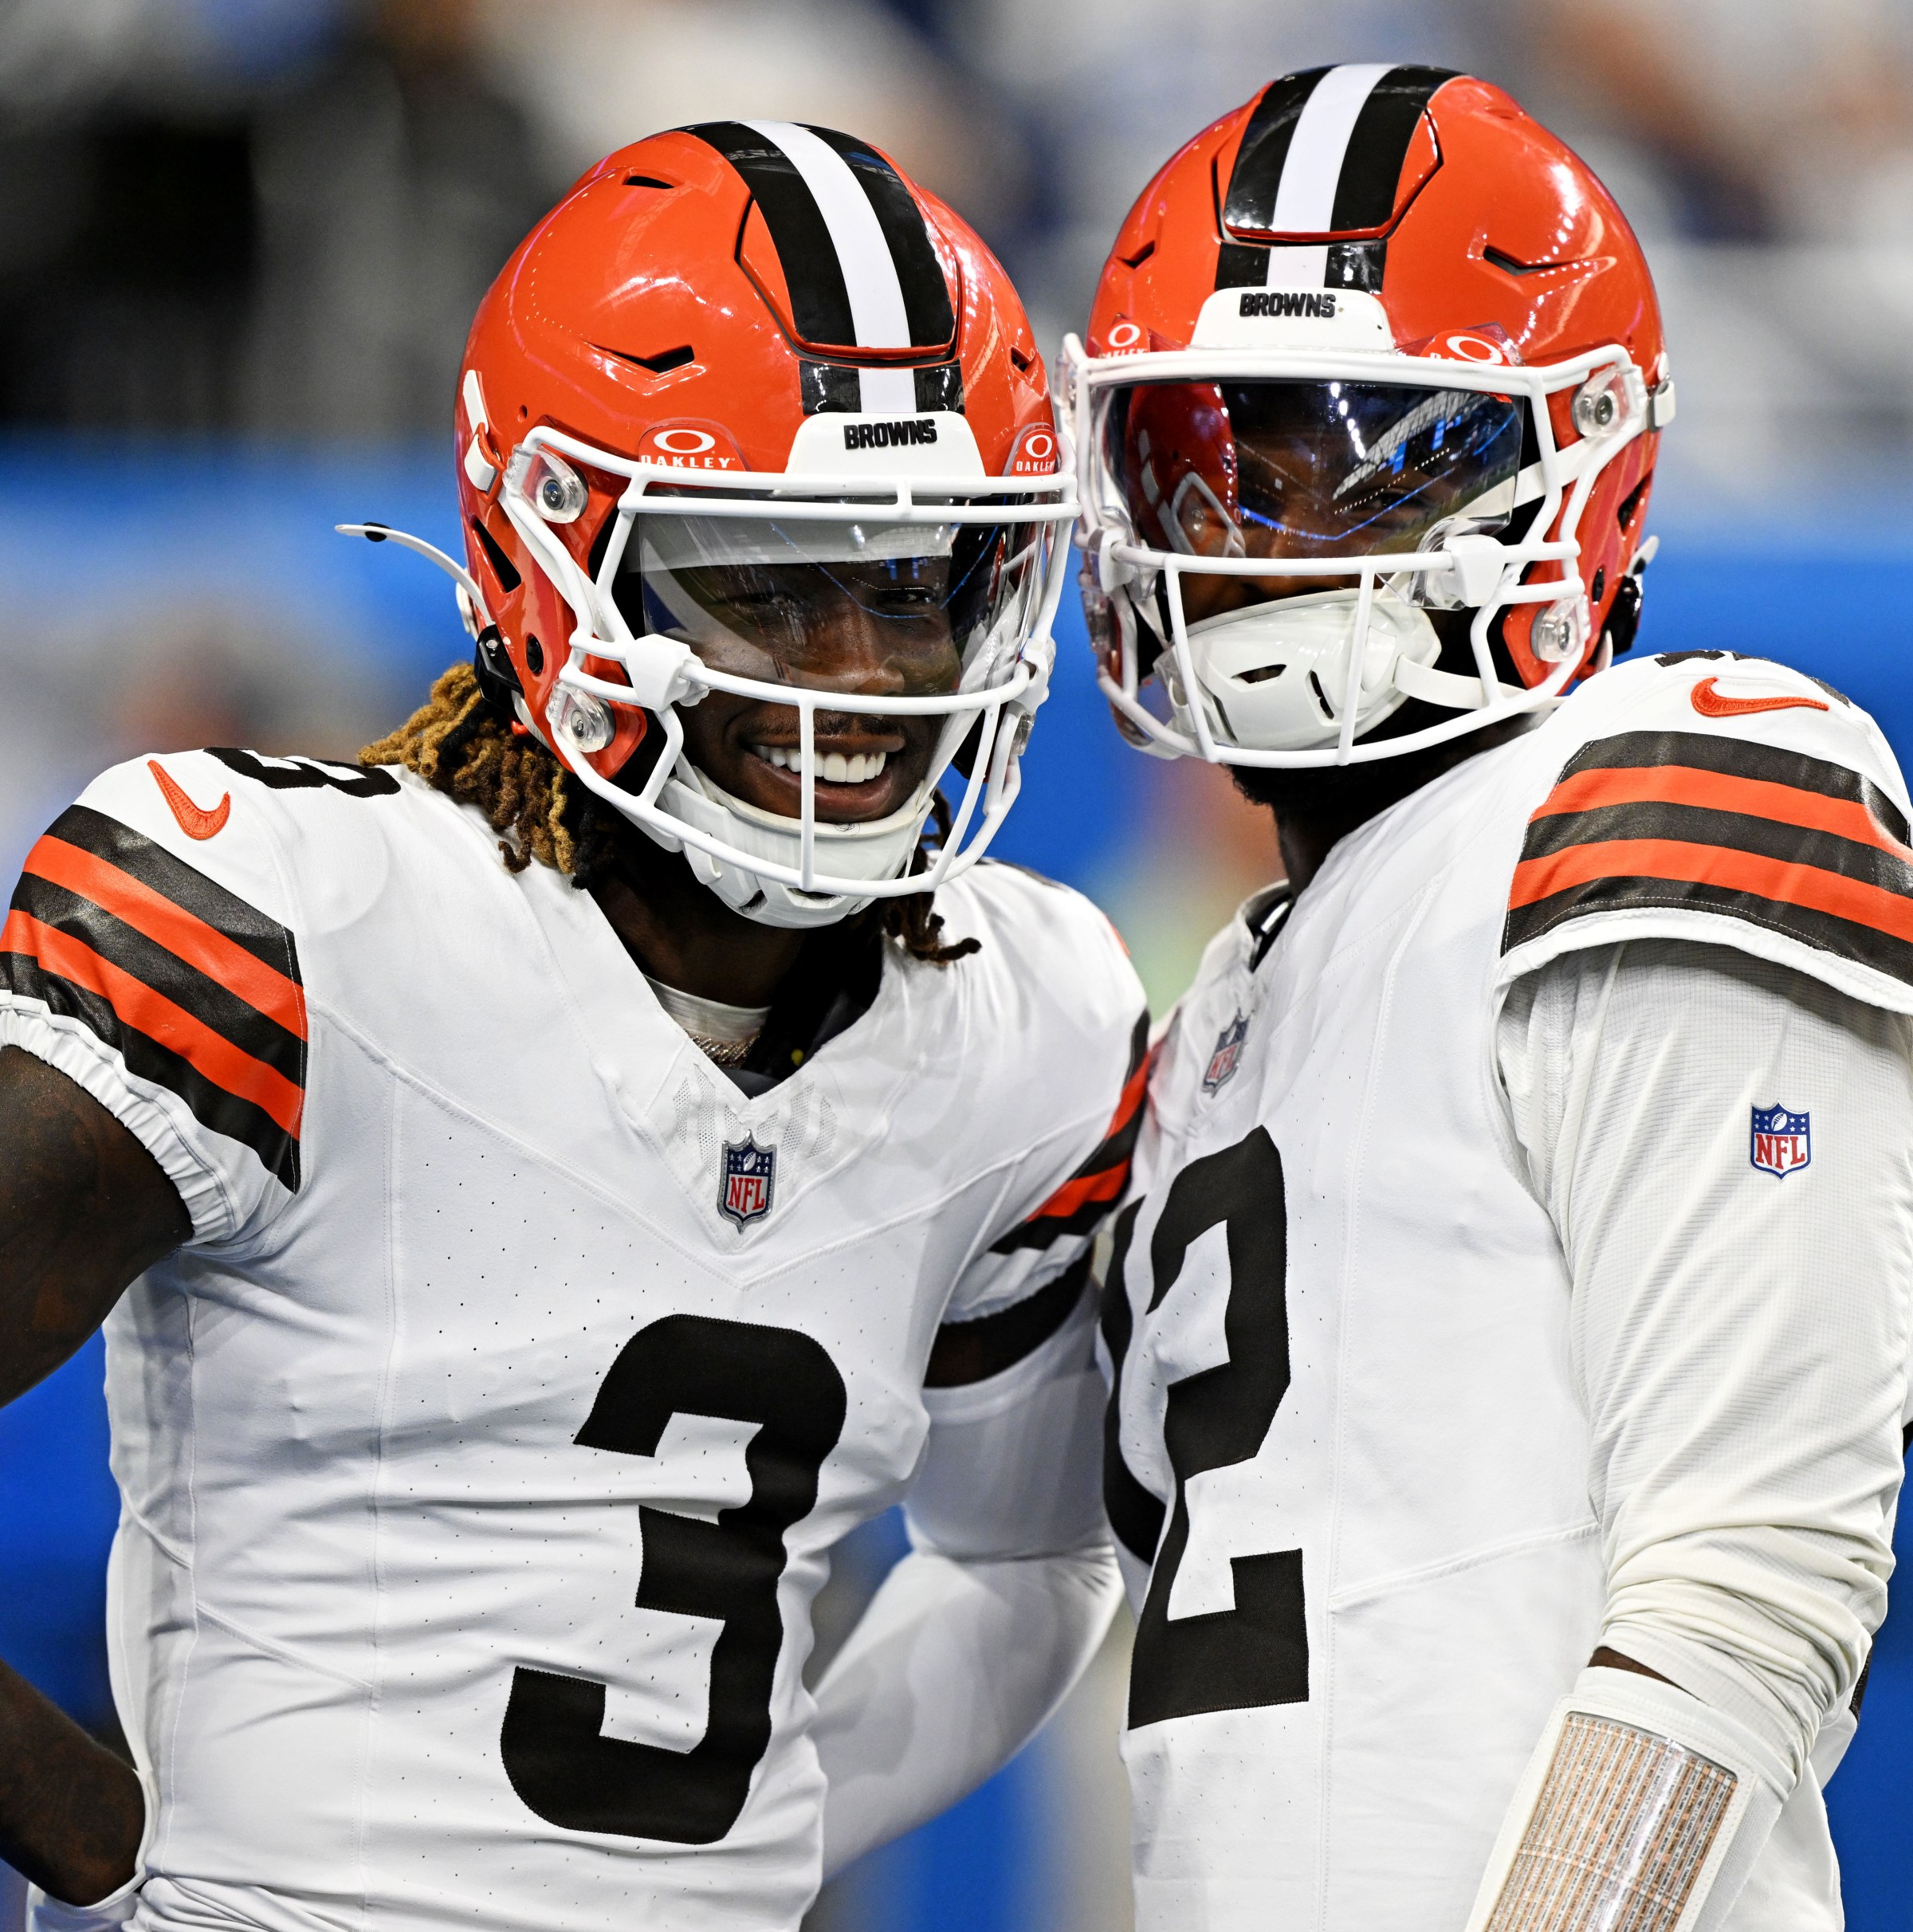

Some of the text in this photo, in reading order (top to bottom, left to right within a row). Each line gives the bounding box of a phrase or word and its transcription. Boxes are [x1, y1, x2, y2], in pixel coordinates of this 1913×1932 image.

[1239, 292, 1337, 318] BROWNS
[843, 418, 938, 450] BROWNS
[640, 454, 730, 469] OAKLEY
[1754, 1133, 1806, 1170] NFL
[726, 1176, 767, 1215] NFL
[500, 1313, 847, 1845] 3
